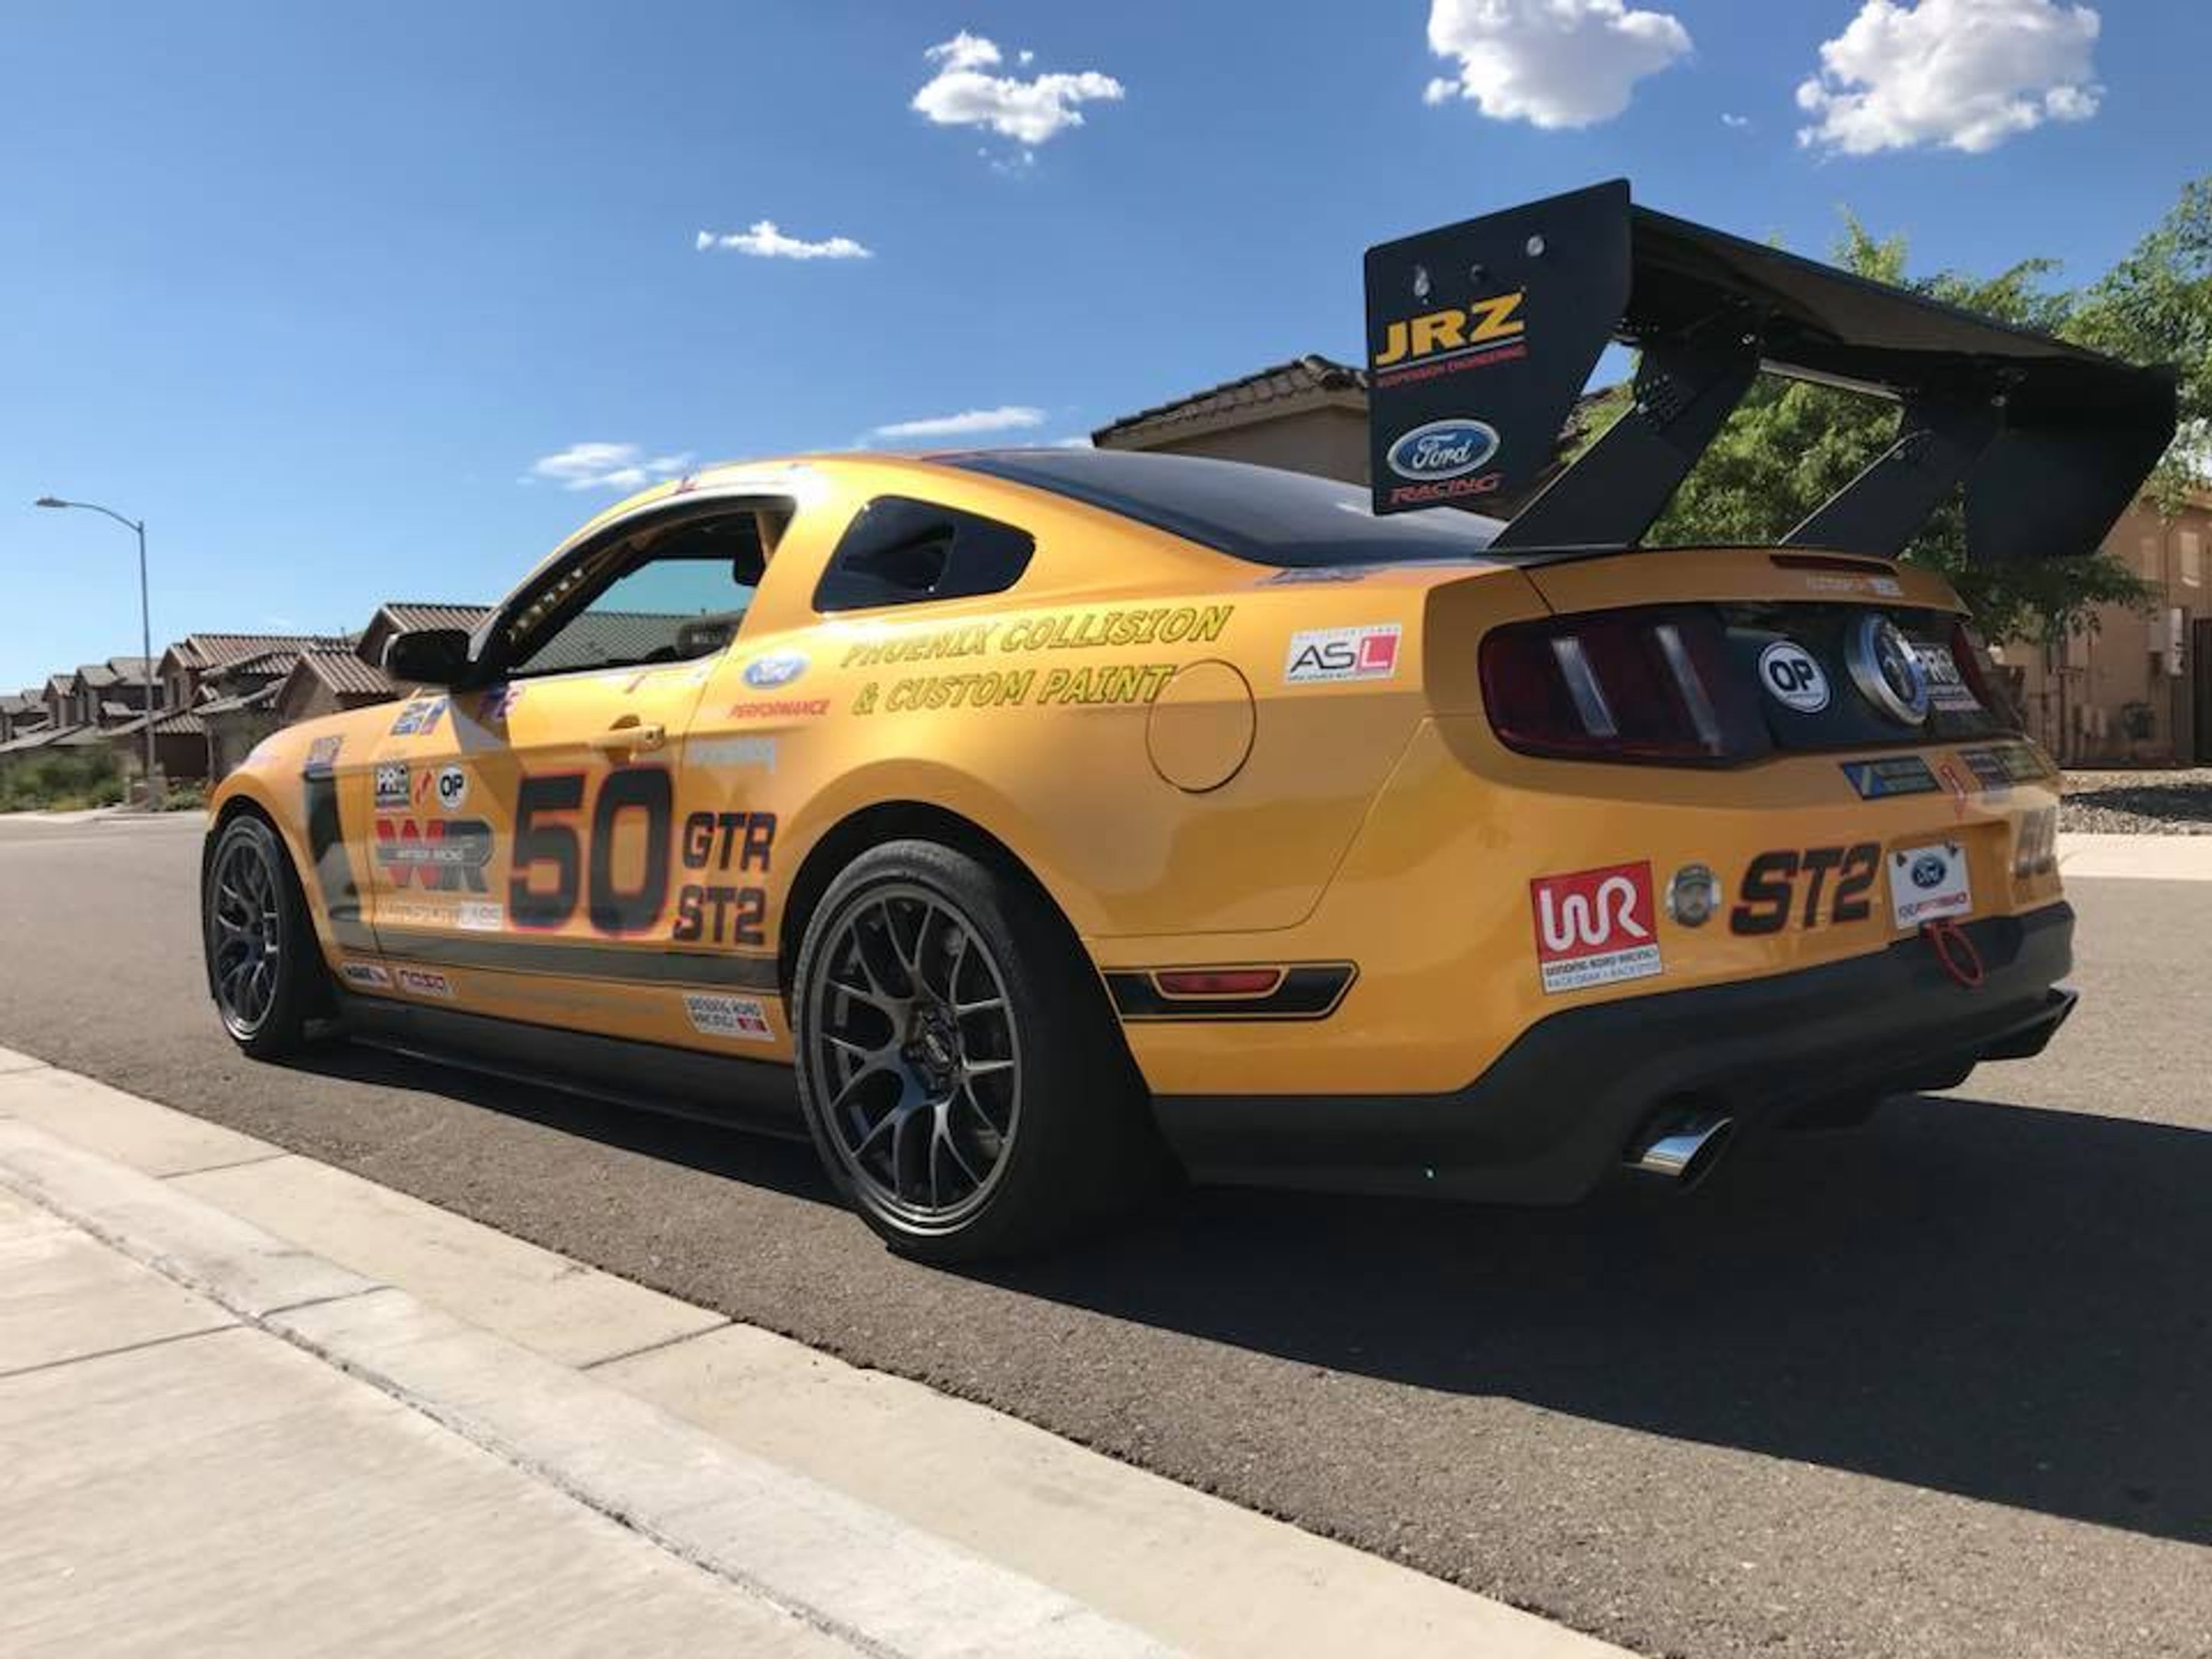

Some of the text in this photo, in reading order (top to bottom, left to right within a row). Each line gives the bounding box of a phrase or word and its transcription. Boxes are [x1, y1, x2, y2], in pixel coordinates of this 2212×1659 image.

[1375, 293, 1525, 365] JRZ
[1412, 433, 1472, 469] Ford
[1389, 472, 1505, 505] RACING
[839, 604, 1235, 669] PHOENIX COLLISION
[1290, 637, 1392, 673] ASL
[850, 664, 1179, 717] & CUSTOM PAINT
[1769, 659, 1815, 692] OP
[729, 698, 830, 720] PERFORMANCE
[439, 774, 465, 797] OP
[508, 761, 674, 937] 50
[681, 810, 778, 873] GTR
[671, 884, 767, 946] ST2
[1730, 843, 1882, 935] ST2
